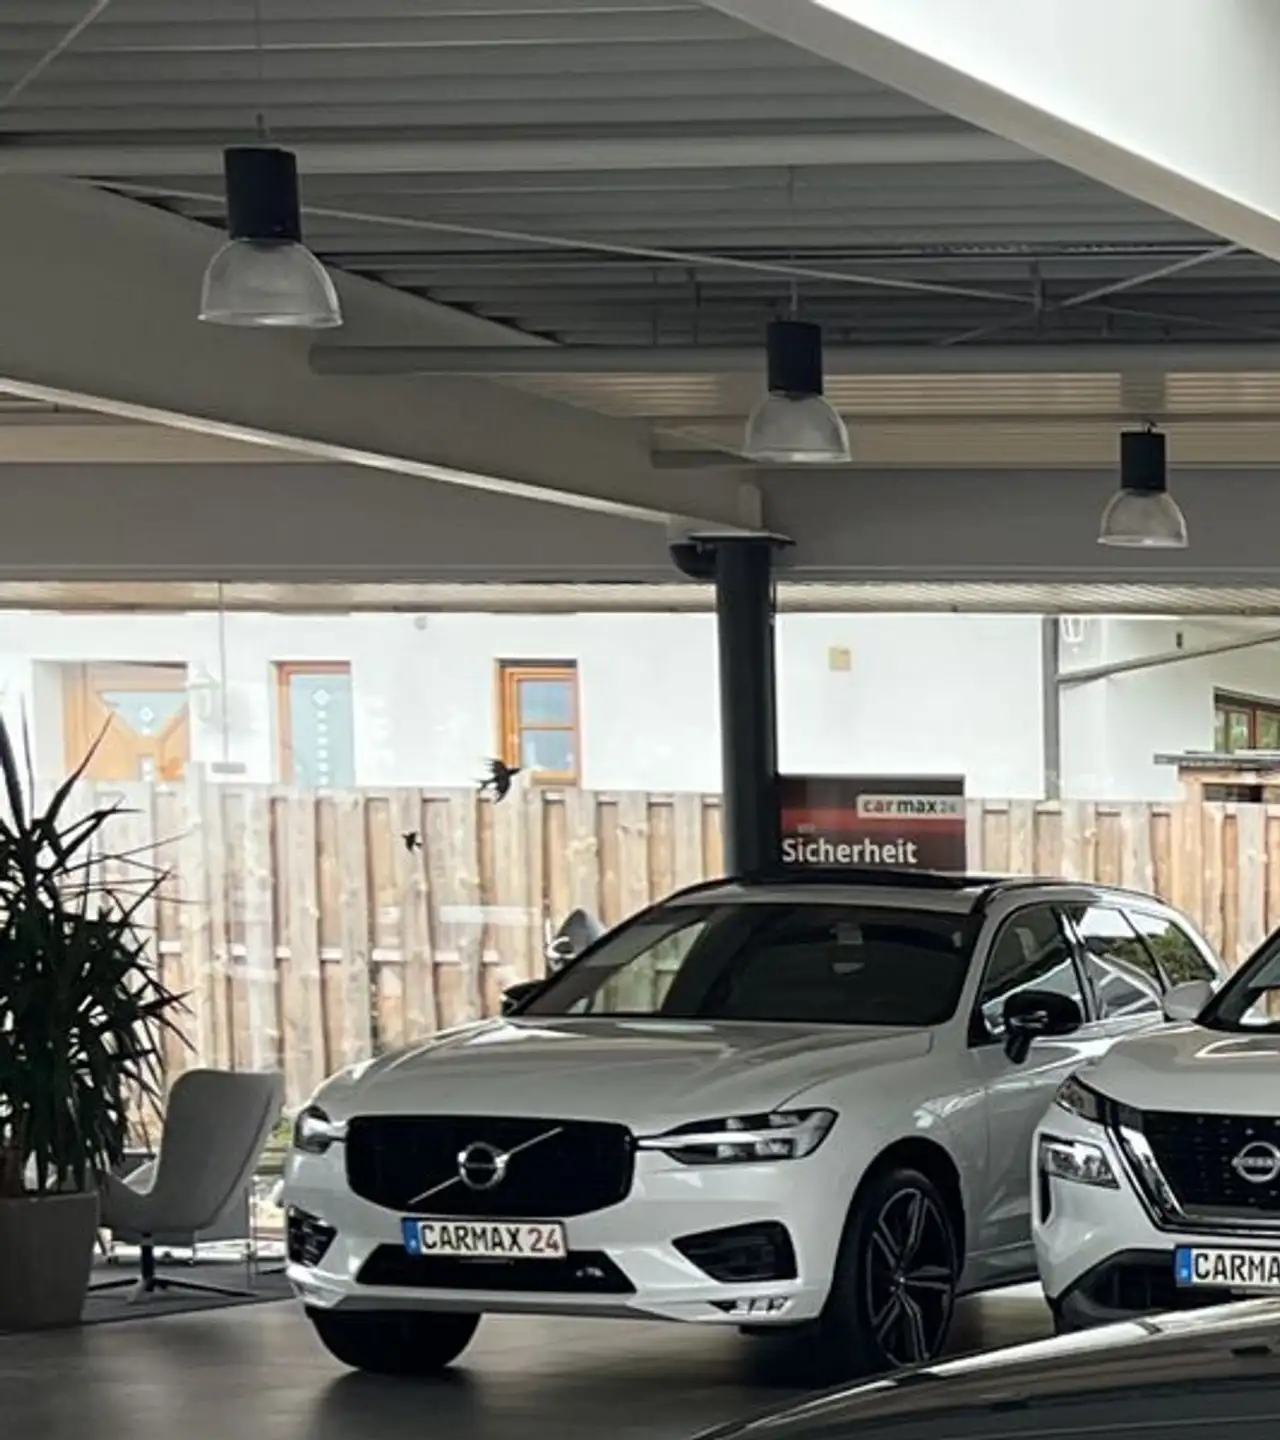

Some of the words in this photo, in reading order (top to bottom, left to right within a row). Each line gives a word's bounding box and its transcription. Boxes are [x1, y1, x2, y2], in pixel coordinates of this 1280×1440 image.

[781, 838, 918, 864] Sicherheit
[421, 1224, 527, 1254] CARMAX
[527, 1228, 560, 1252] 24
